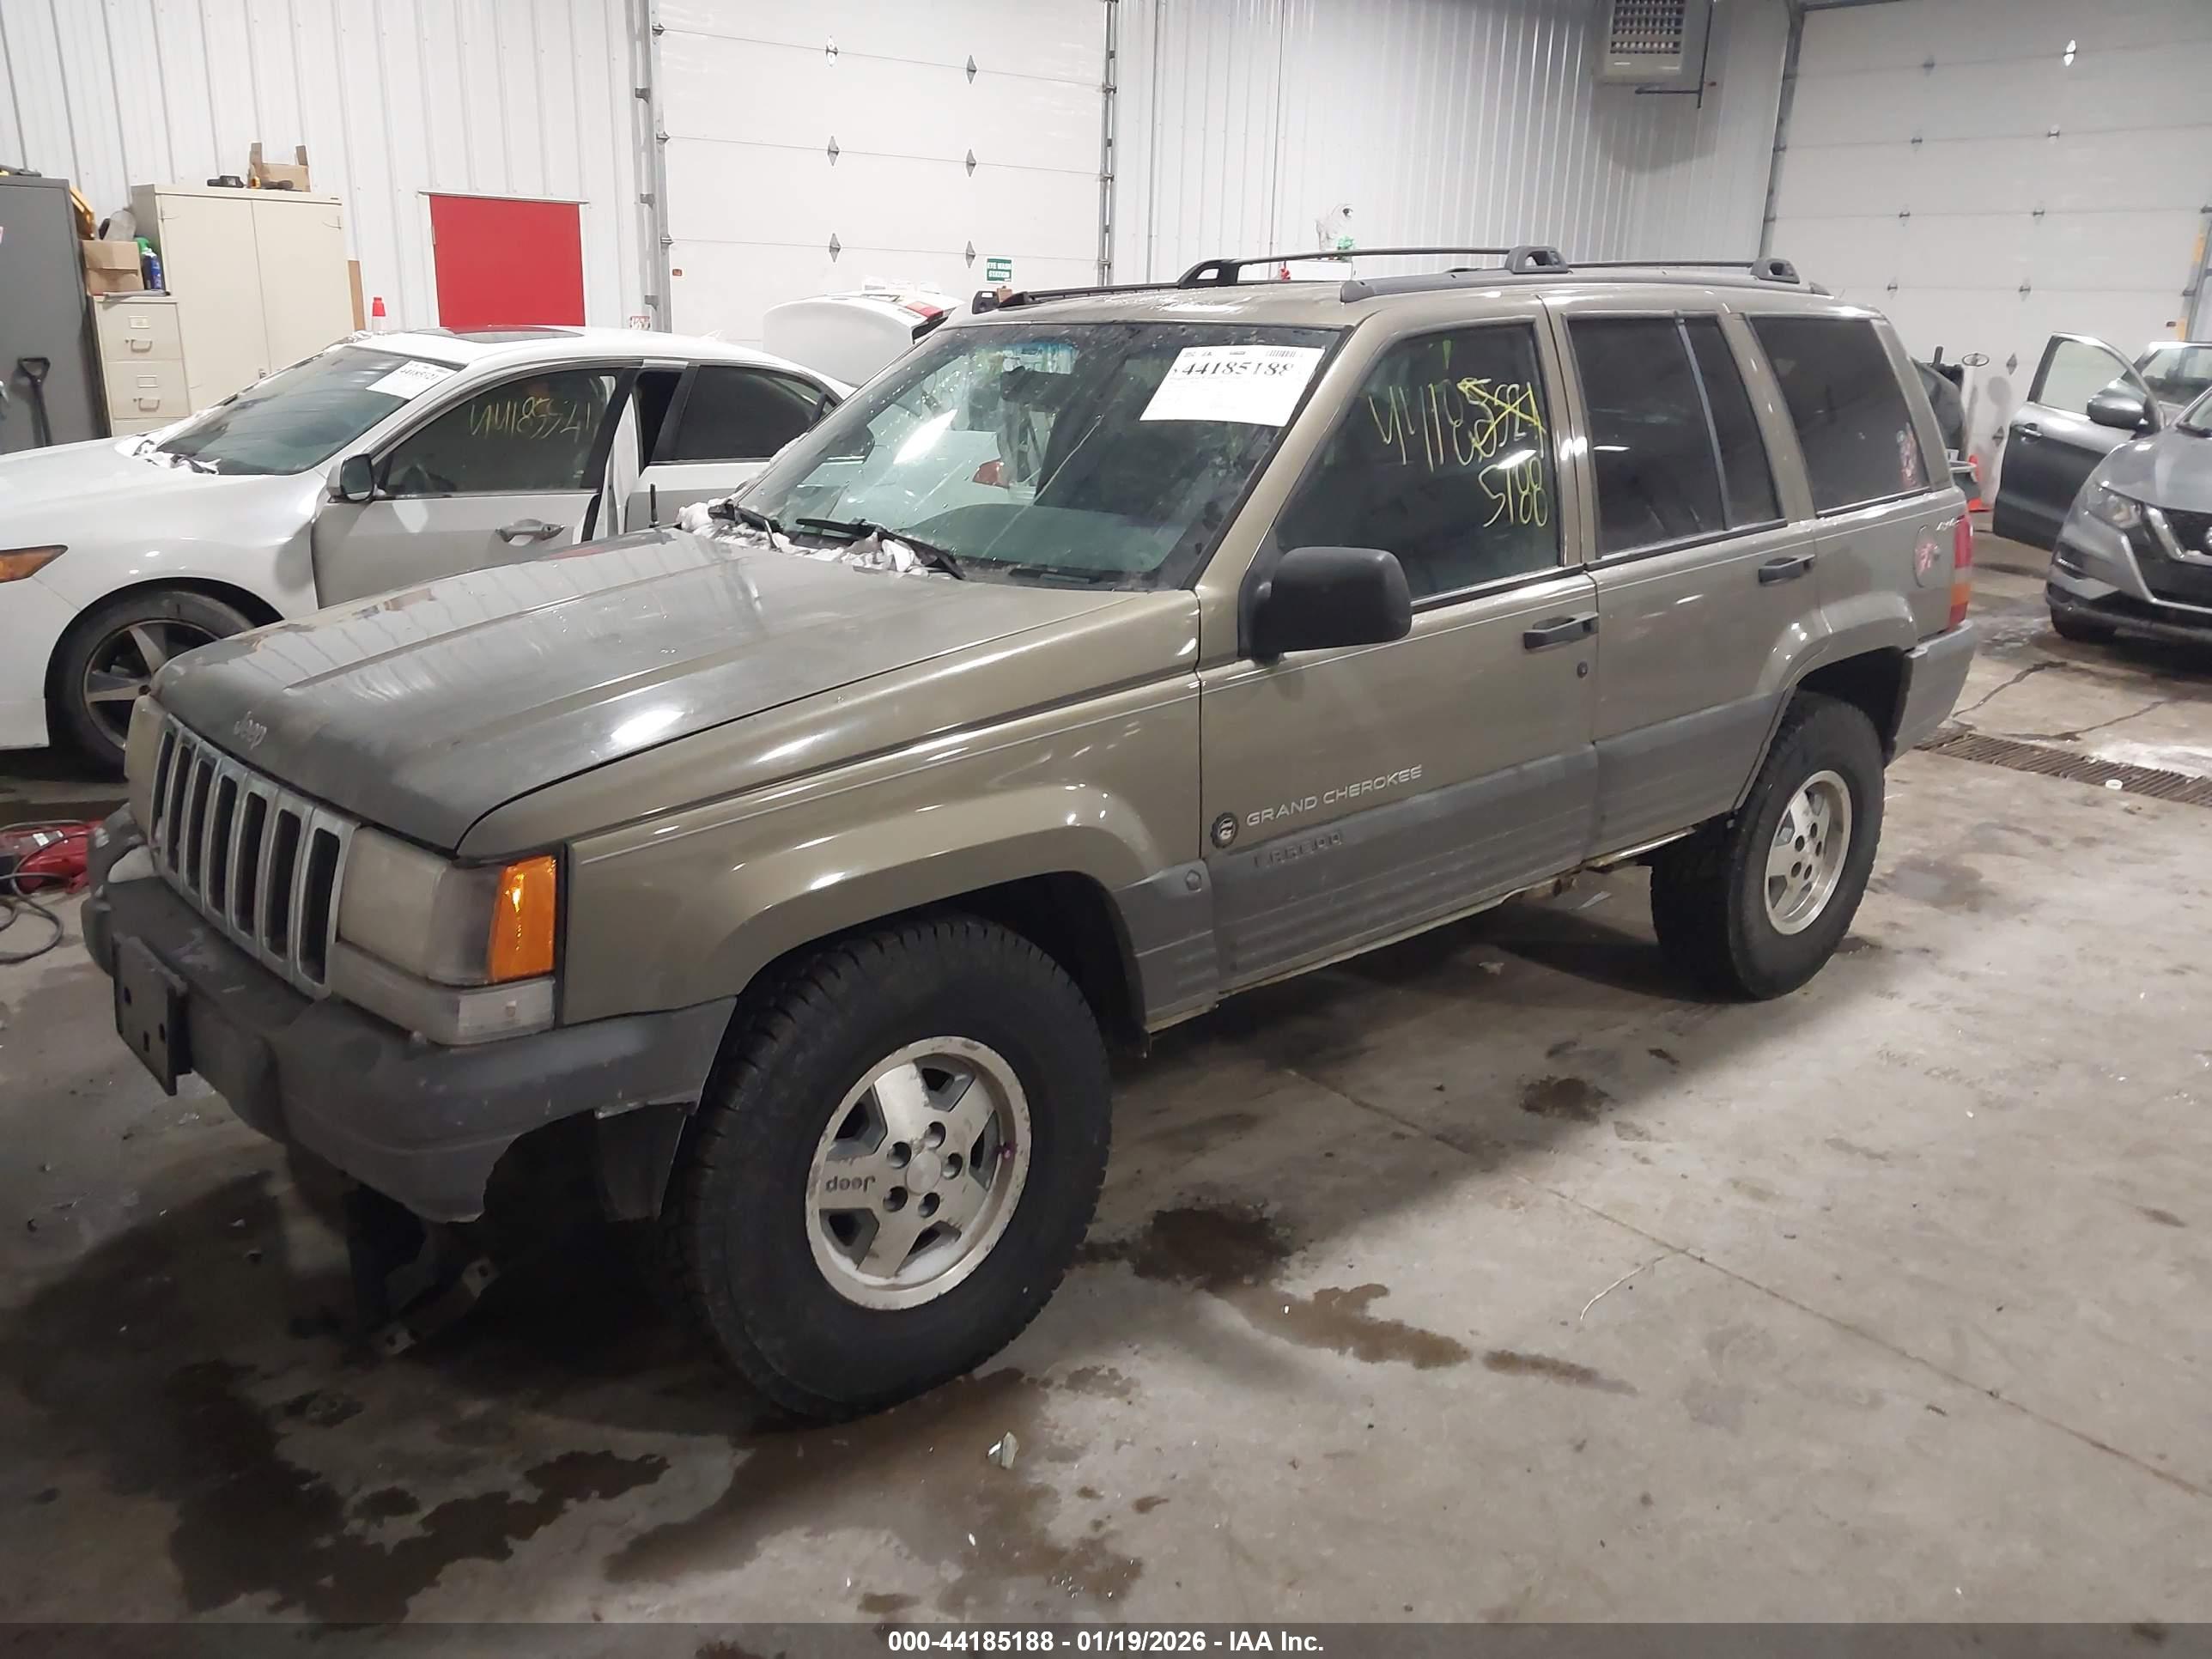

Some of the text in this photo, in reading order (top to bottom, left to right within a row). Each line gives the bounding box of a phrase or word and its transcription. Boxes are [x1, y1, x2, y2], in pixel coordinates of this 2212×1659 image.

[1478, 456, 1549, 528] 5188
[1245, 764, 1422, 828] GRAND CHEROKEE
[825, 1176, 876, 1192] Jeep
